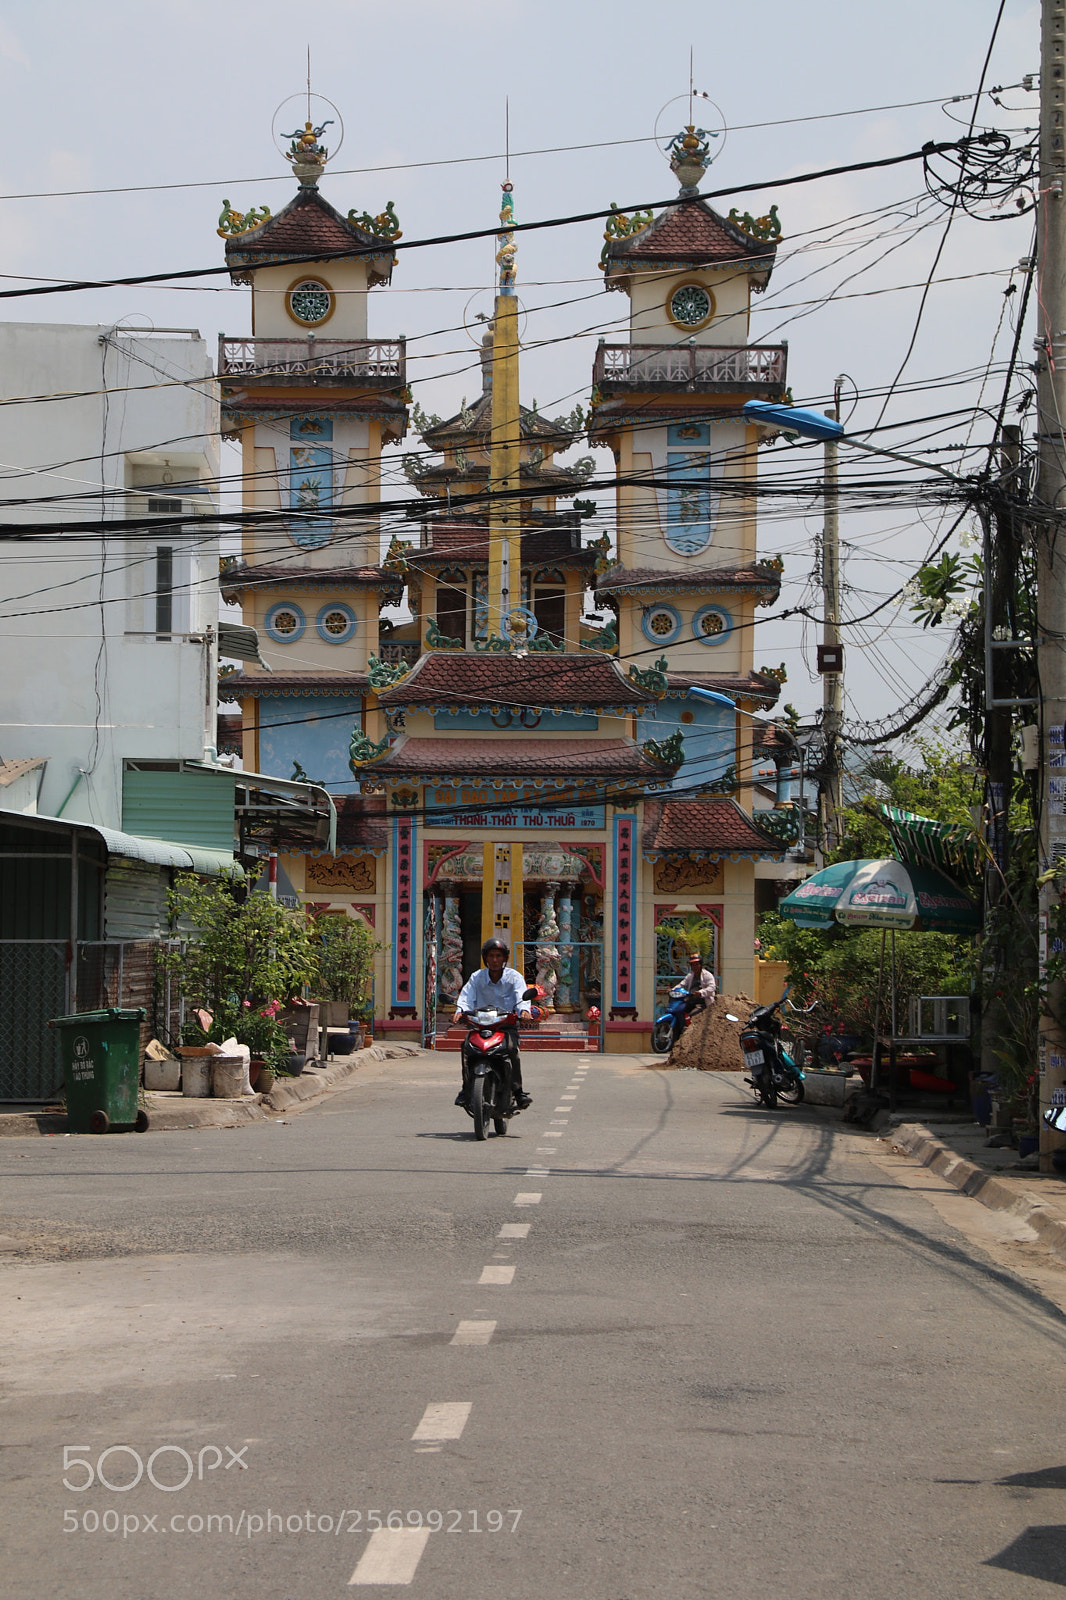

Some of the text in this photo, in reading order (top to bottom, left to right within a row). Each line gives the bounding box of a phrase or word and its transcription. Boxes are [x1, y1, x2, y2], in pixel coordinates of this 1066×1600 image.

[795, 882, 843, 898] Meizan
[852, 892, 906, 905] Meizan
[918, 891, 972, 910] Meizan
